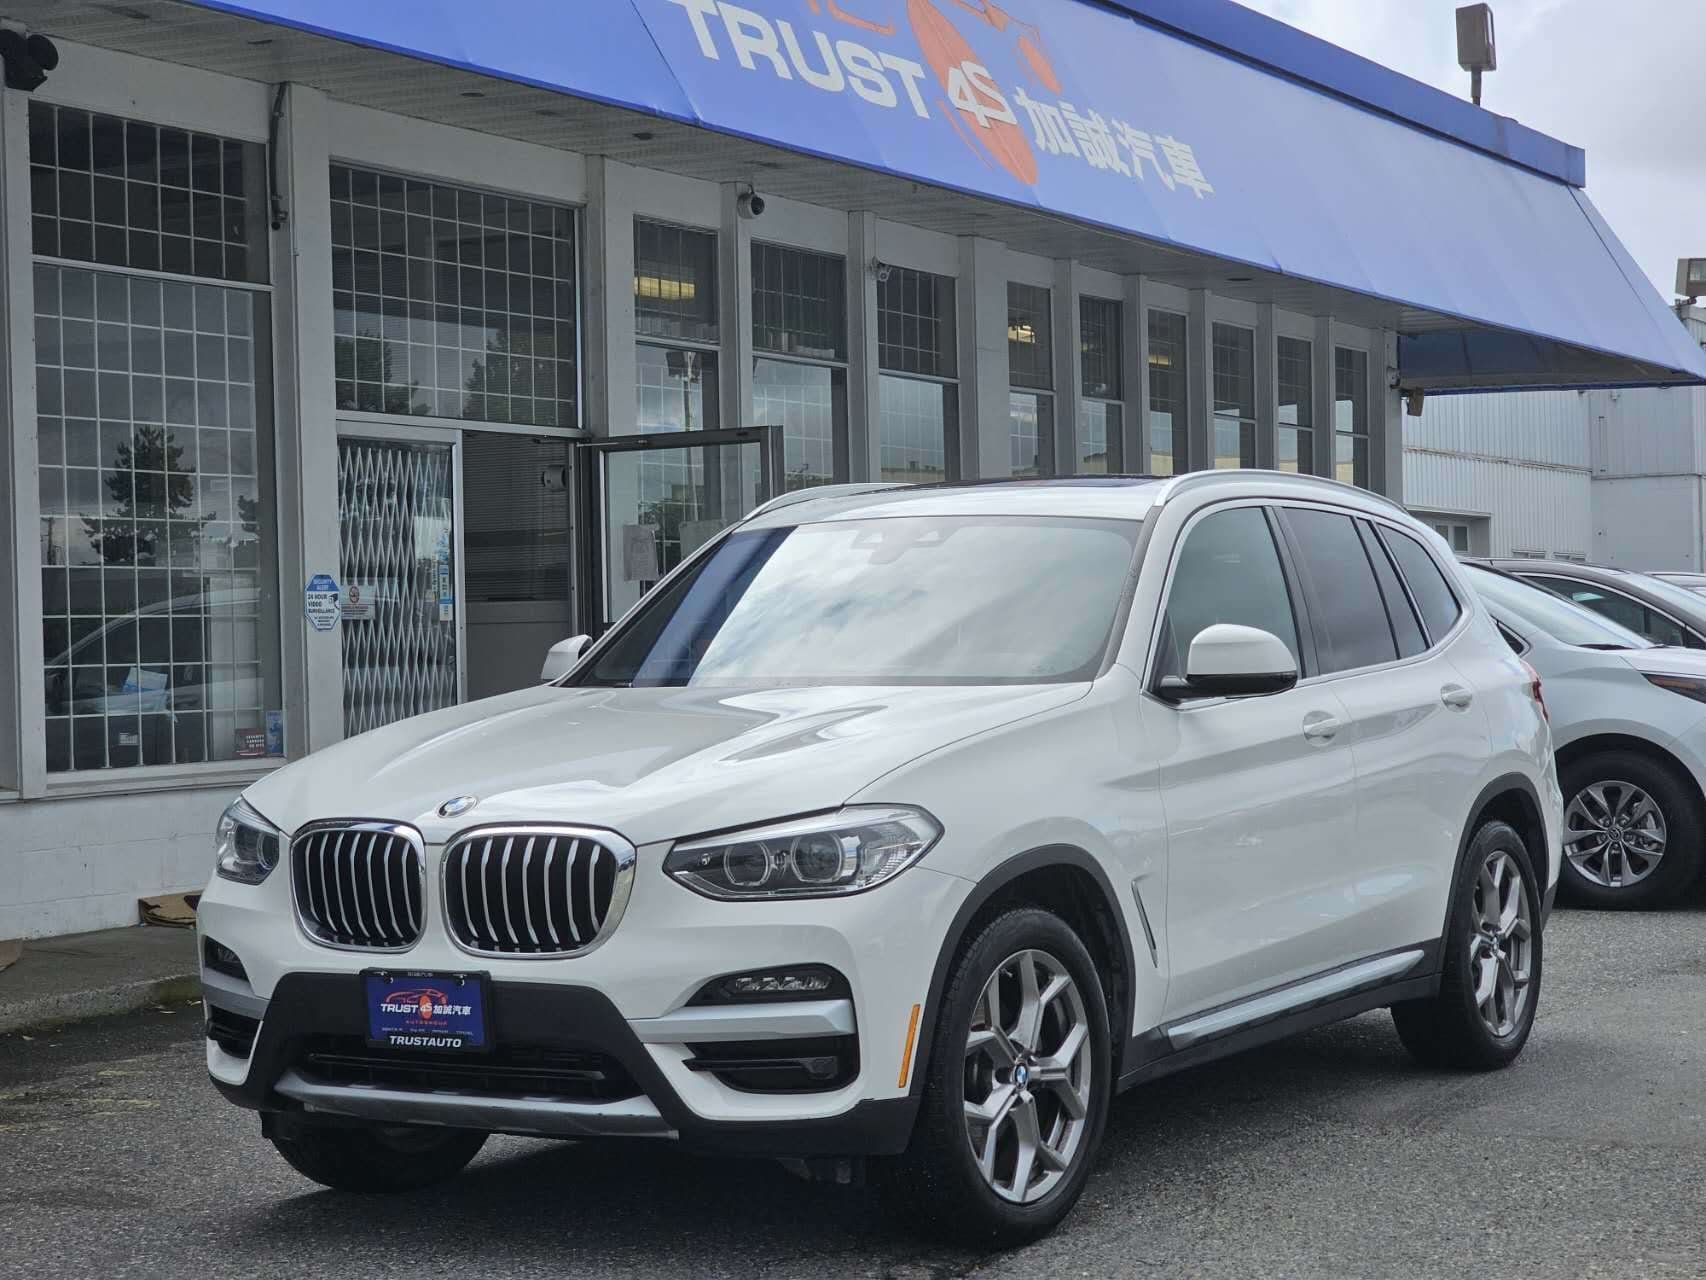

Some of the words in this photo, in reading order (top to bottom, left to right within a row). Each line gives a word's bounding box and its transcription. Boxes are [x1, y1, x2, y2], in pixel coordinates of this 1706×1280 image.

[665, 0, 930, 119] TRUST
[947, 59, 1017, 129] 4S
[1012, 86, 1215, 199] 加誠汽車
[380, 1003, 419, 1013] TRUST
[389, 1035, 462, 1048] TRUSTAUTO
